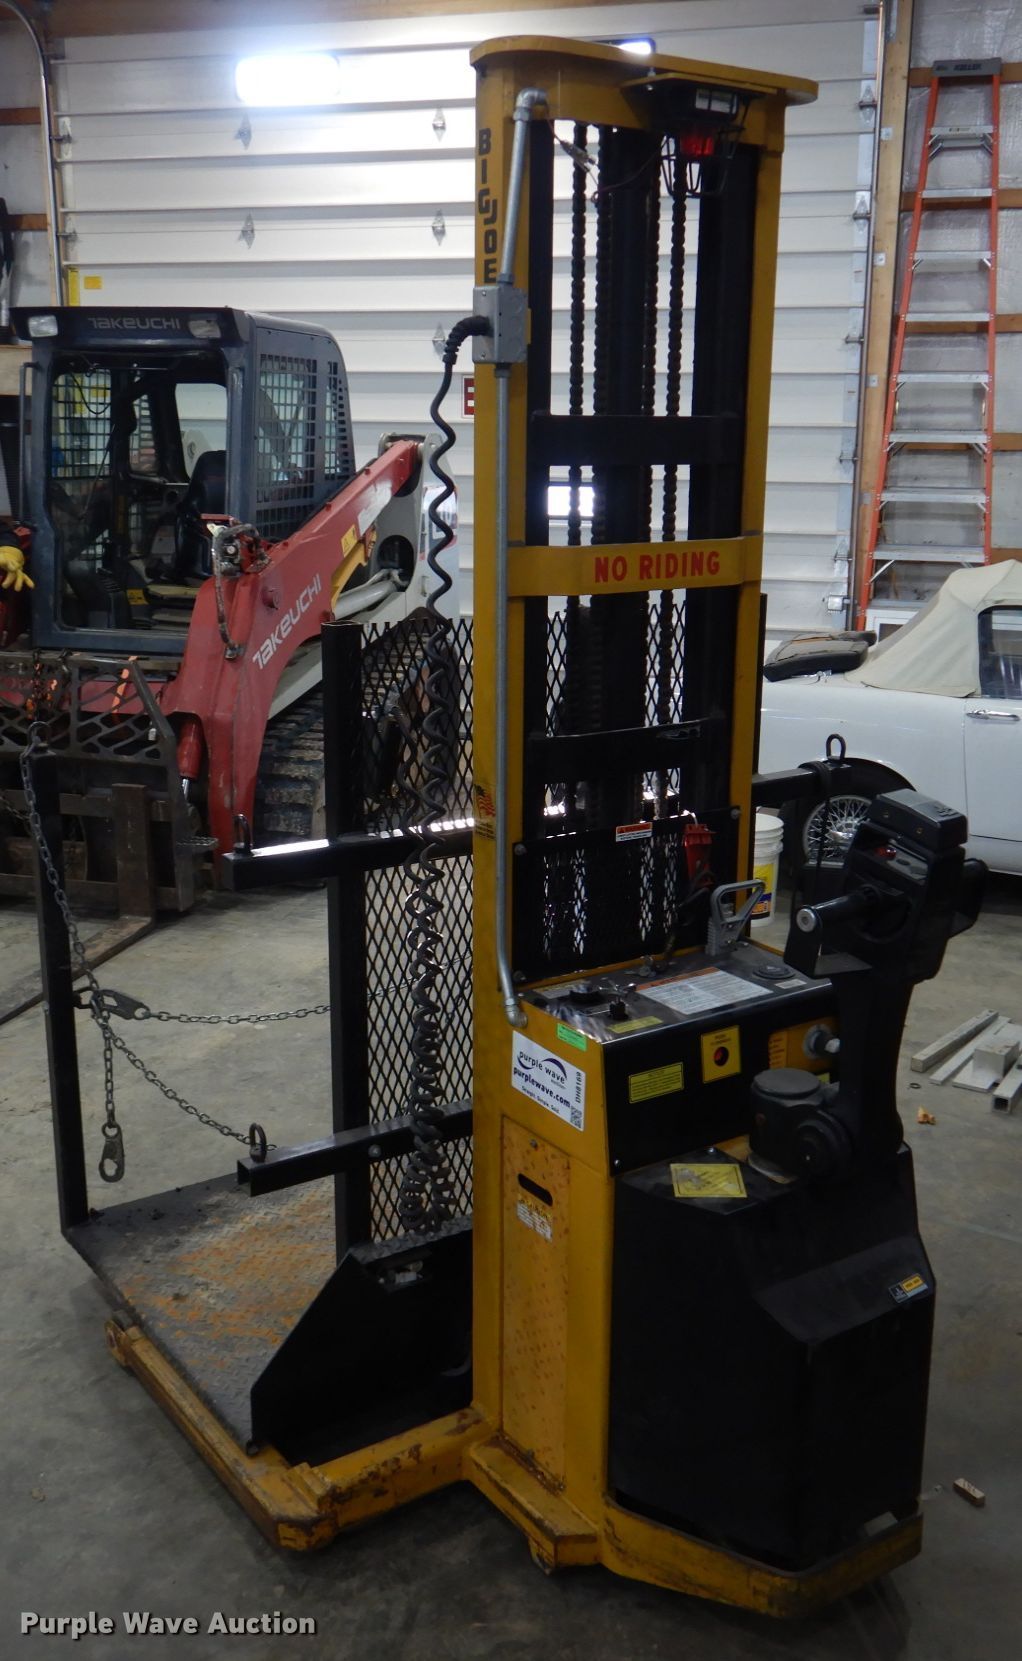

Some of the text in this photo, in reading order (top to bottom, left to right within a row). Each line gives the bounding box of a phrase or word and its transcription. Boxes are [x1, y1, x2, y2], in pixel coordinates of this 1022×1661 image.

[478, 128, 497, 284] BIG JOE
[88, 317, 180, 329] TAKEUCHI
[595, 551, 720, 583] NO RIDING
[252, 573, 321, 670] TAKEUCHI
[519, 1051, 565, 1084] purple wave
[513, 1066, 571, 1107] purplewave.com
